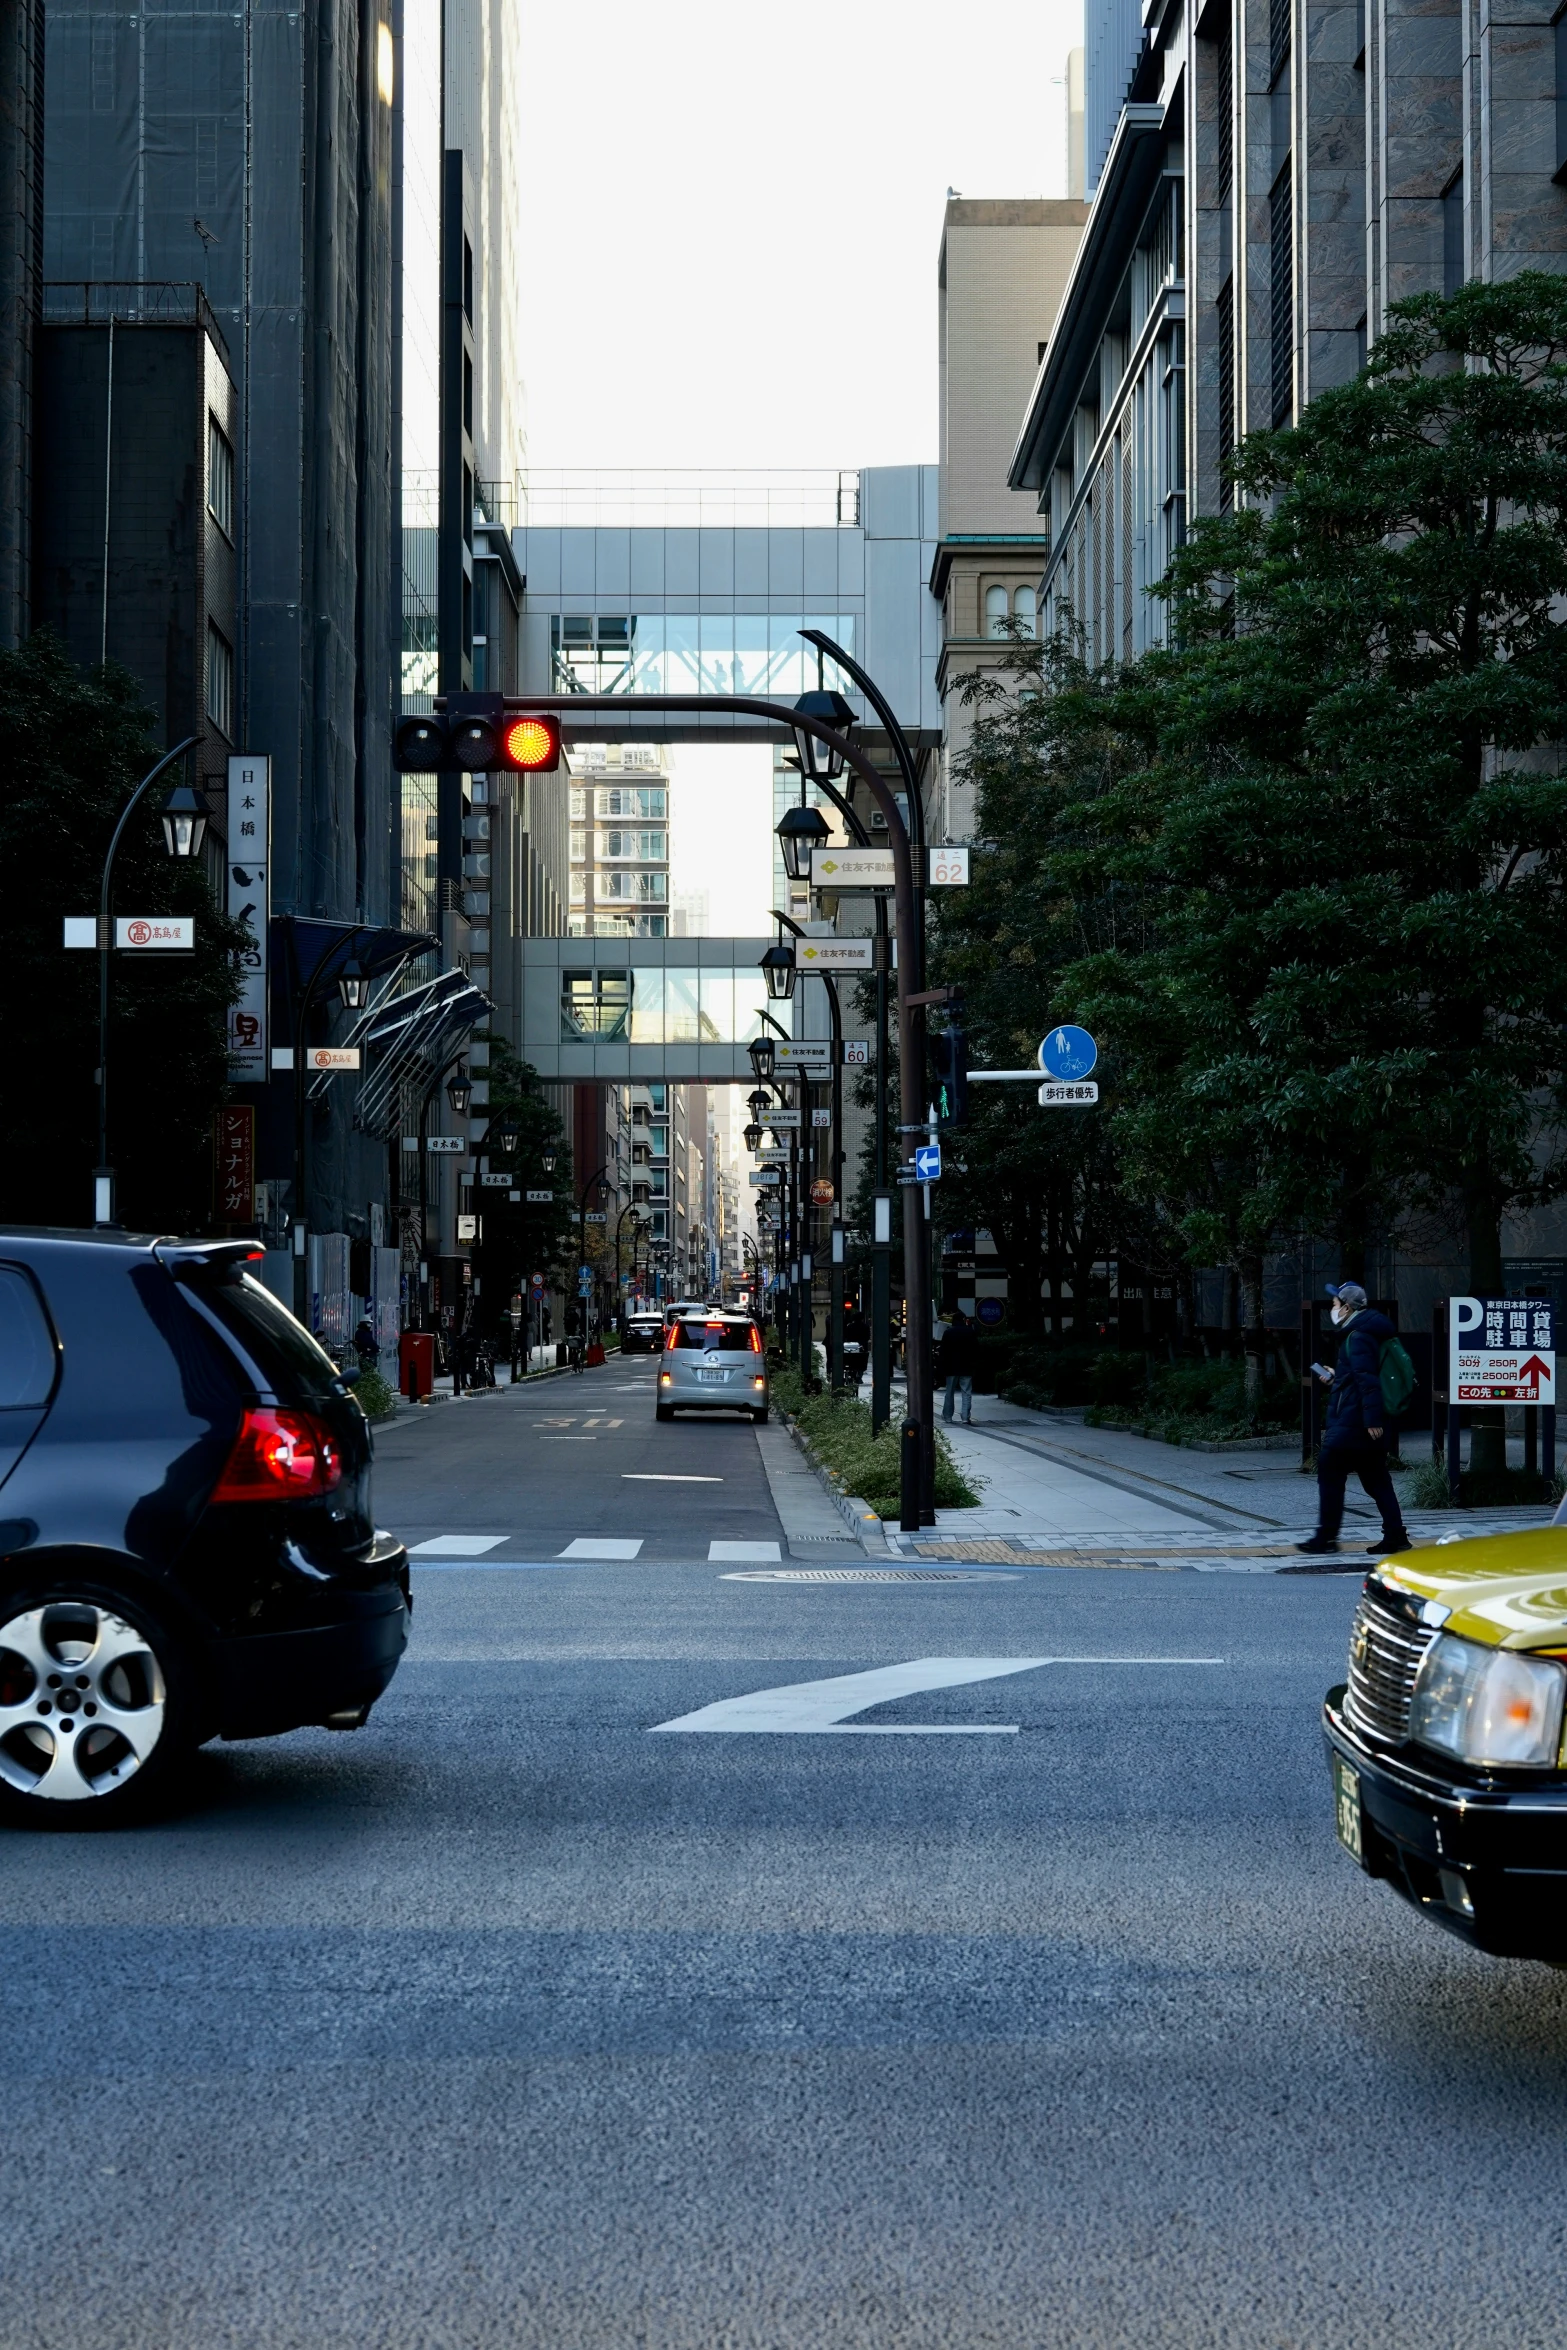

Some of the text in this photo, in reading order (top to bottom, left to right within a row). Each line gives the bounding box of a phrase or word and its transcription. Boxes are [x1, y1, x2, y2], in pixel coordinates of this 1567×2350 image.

[240, 770, 255, 836] 日本橋
[841, 861, 895, 873] 住友不動産
[935, 864, 962, 883] 62
[820, 949, 866, 958] 住友不動産
[792, 1048, 826, 1056] 住友不動産
[847, 1050, 865, 1062] 60
[1046, 1086, 1095, 1100] 歩行者優先
[814, 1116, 828, 1126] 59
[432, 1139, 459, 1149] 日本橋
[225, 1116, 244, 1210] ショナルガ
[486, 1175, 508, 1184] 日本橋
[530, 1192, 550, 1200] 日本橋
[812, 1187, 833, 1197] 消火栓
[1486, 1300, 1551, 1310] 東京日本橋タワー
[1450, 1297, 1484, 1350] P
[1486, 1311, 1551, 1329] 時間貸
[1486, 1330, 1551, 1348] 駐車場
[1482, 1372, 1518, 1381] 2500円
[1460, 1387, 1538, 1399] この先 左折
[531, 1418, 625, 1429] 30
